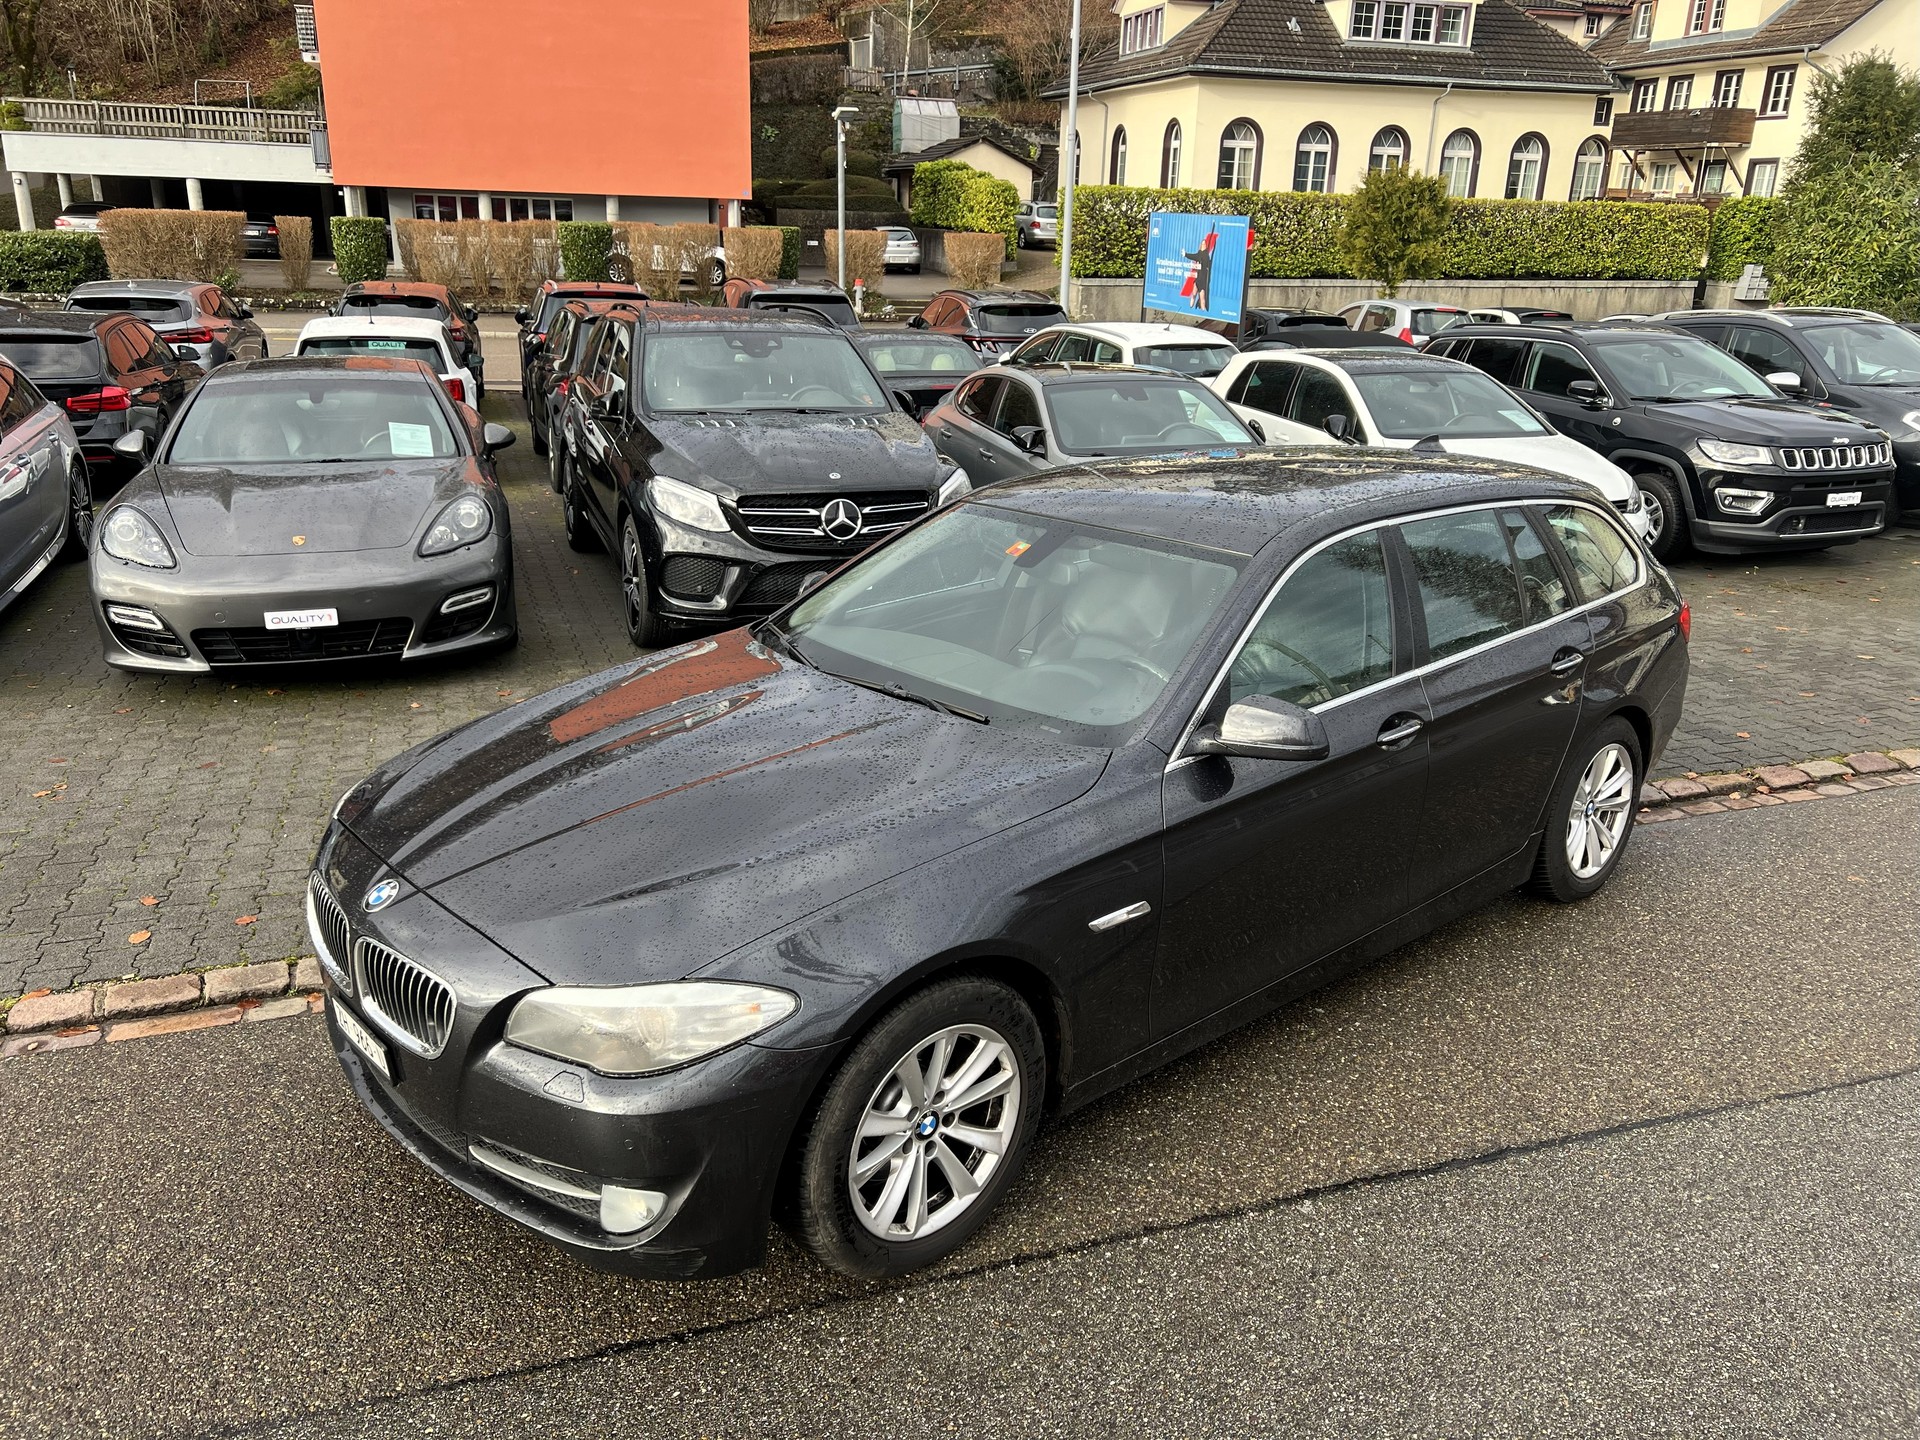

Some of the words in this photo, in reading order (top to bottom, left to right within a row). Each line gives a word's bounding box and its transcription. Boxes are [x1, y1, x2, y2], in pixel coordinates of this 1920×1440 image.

[1830, 495, 1855, 503] QUALITY
[270, 614, 325, 625] QUALITY
[327, 613, 333, 621] 1
